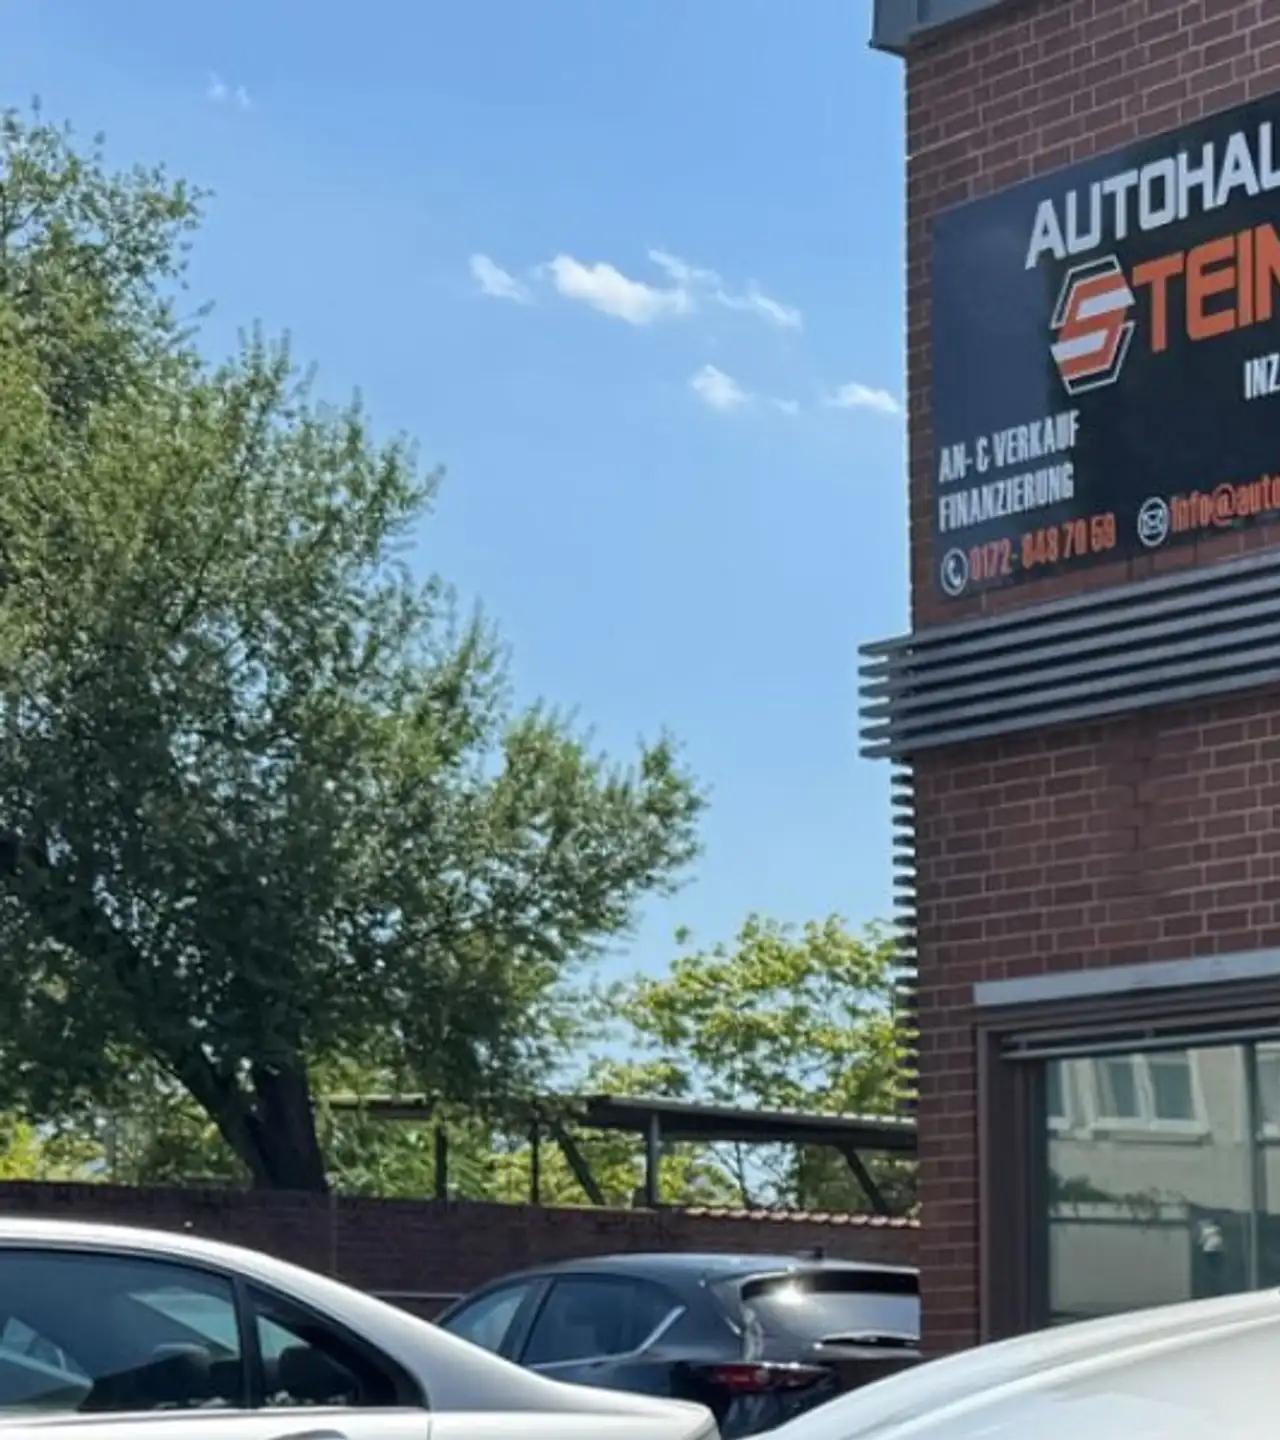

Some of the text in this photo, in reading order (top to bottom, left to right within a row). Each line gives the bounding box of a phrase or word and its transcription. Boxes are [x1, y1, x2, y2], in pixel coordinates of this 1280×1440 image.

[938, 441, 973, 484] AN-
[991, 409, 1080, 468] VERKAUF
[938, 460, 1074, 533] FINANZIERUNG
